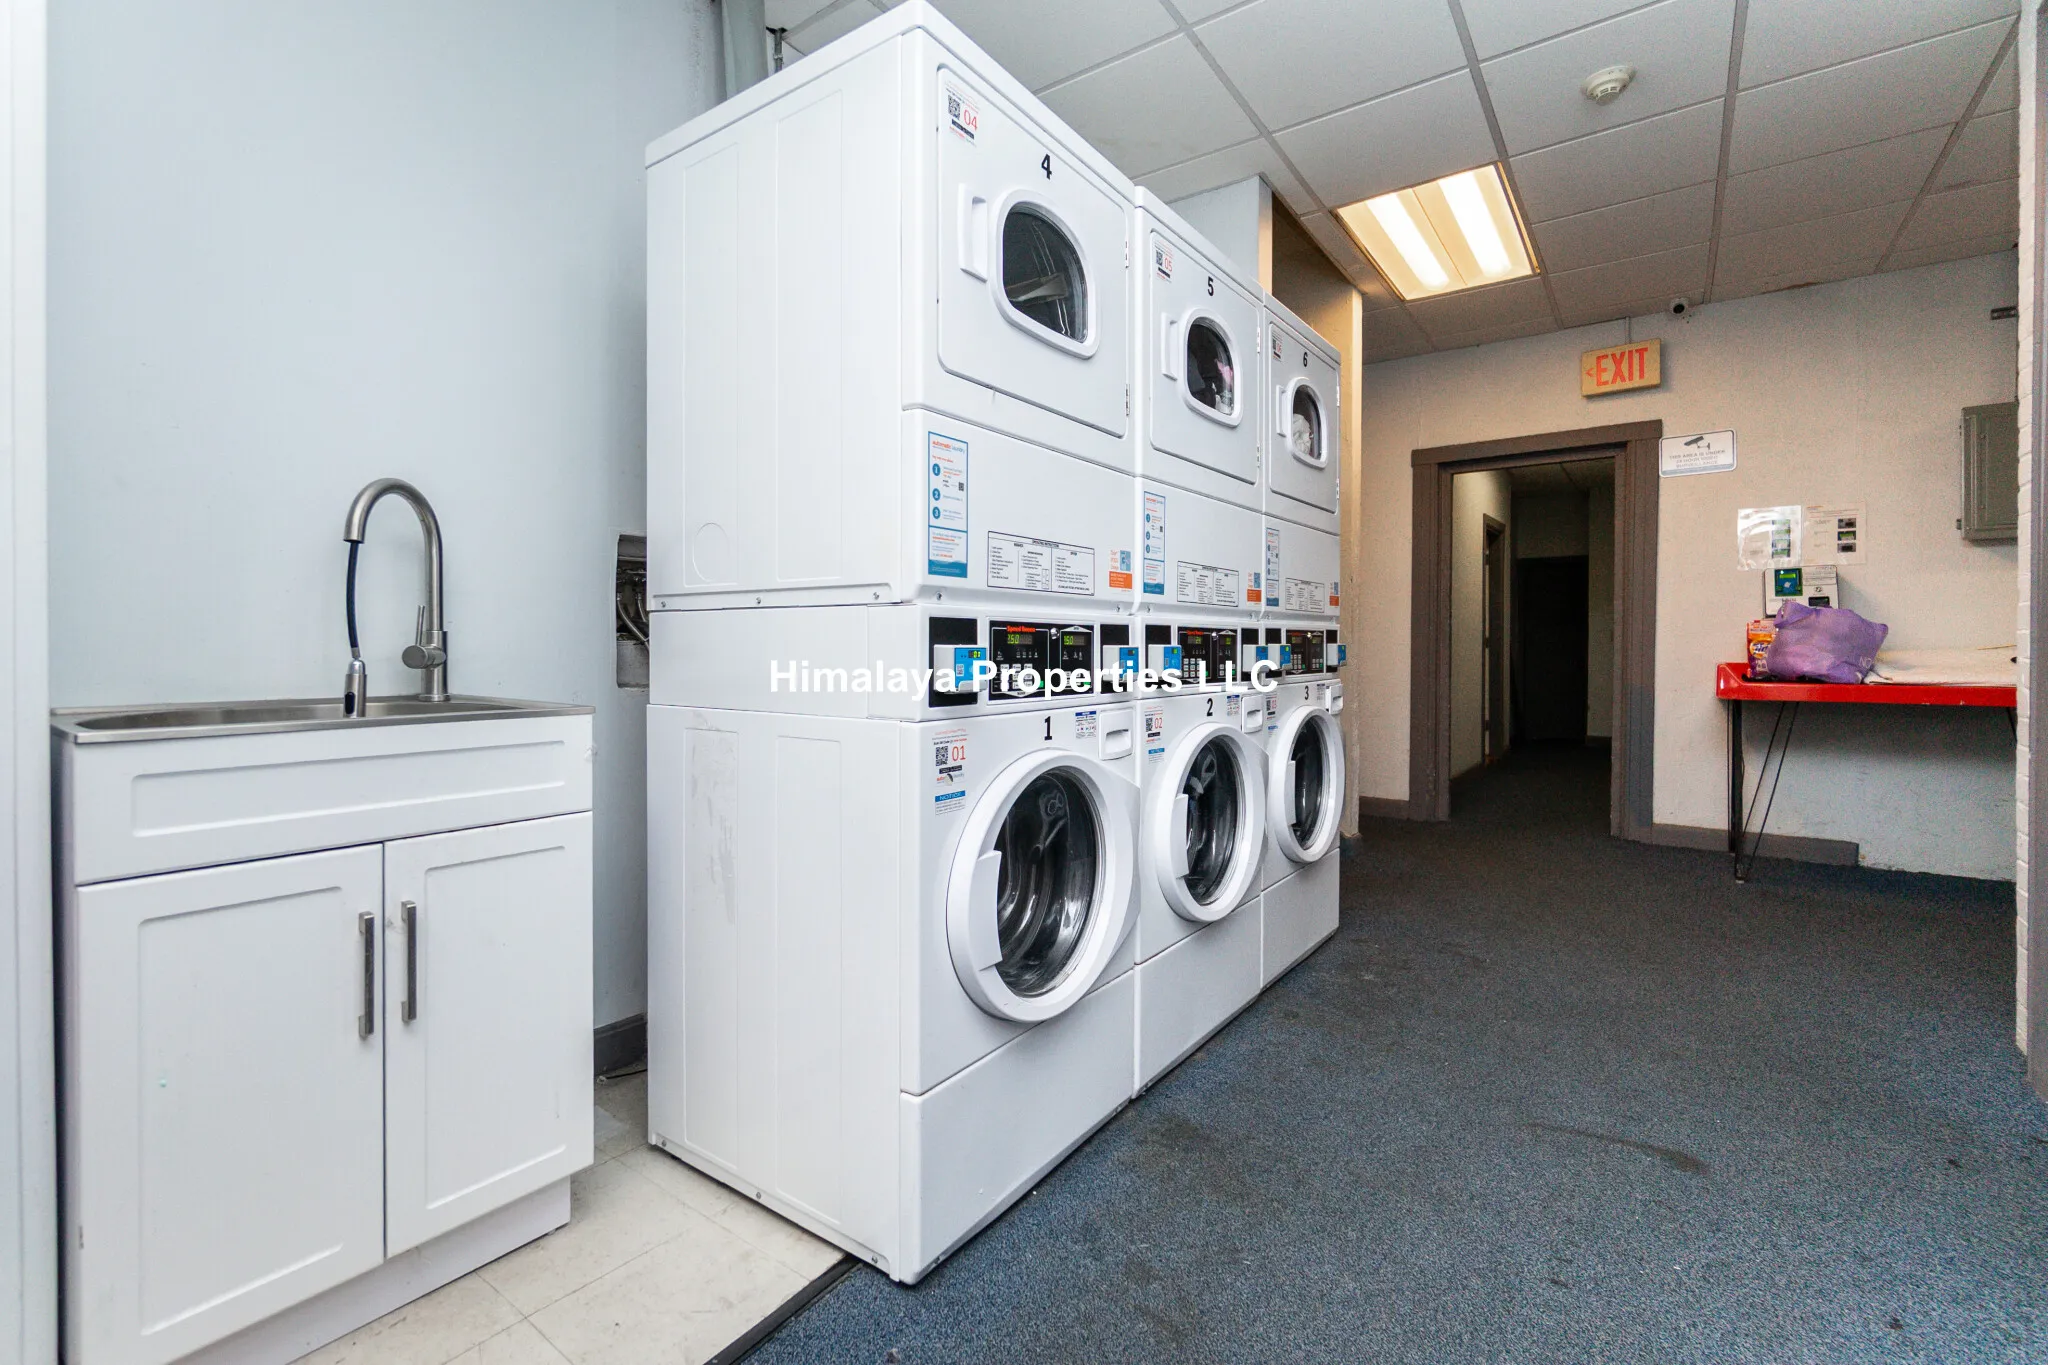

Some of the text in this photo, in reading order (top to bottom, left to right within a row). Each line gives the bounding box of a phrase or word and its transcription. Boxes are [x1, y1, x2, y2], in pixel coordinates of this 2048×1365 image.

[963, 109, 978, 131] 04
[1041, 153, 1052, 180] 4
[1164, 257, 1173, 273] 05
[1207, 275, 1214, 297] 5
[1303, 351, 1308, 368] 6
[1595, 347, 1649, 387] EXIT
[1304, 685, 1310, 700] 3
[1206, 697, 1213, 717] 2
[1044, 715, 1053, 741] 1
[1154, 717, 1163, 729] 02
[952, 745, 966, 762] 01
